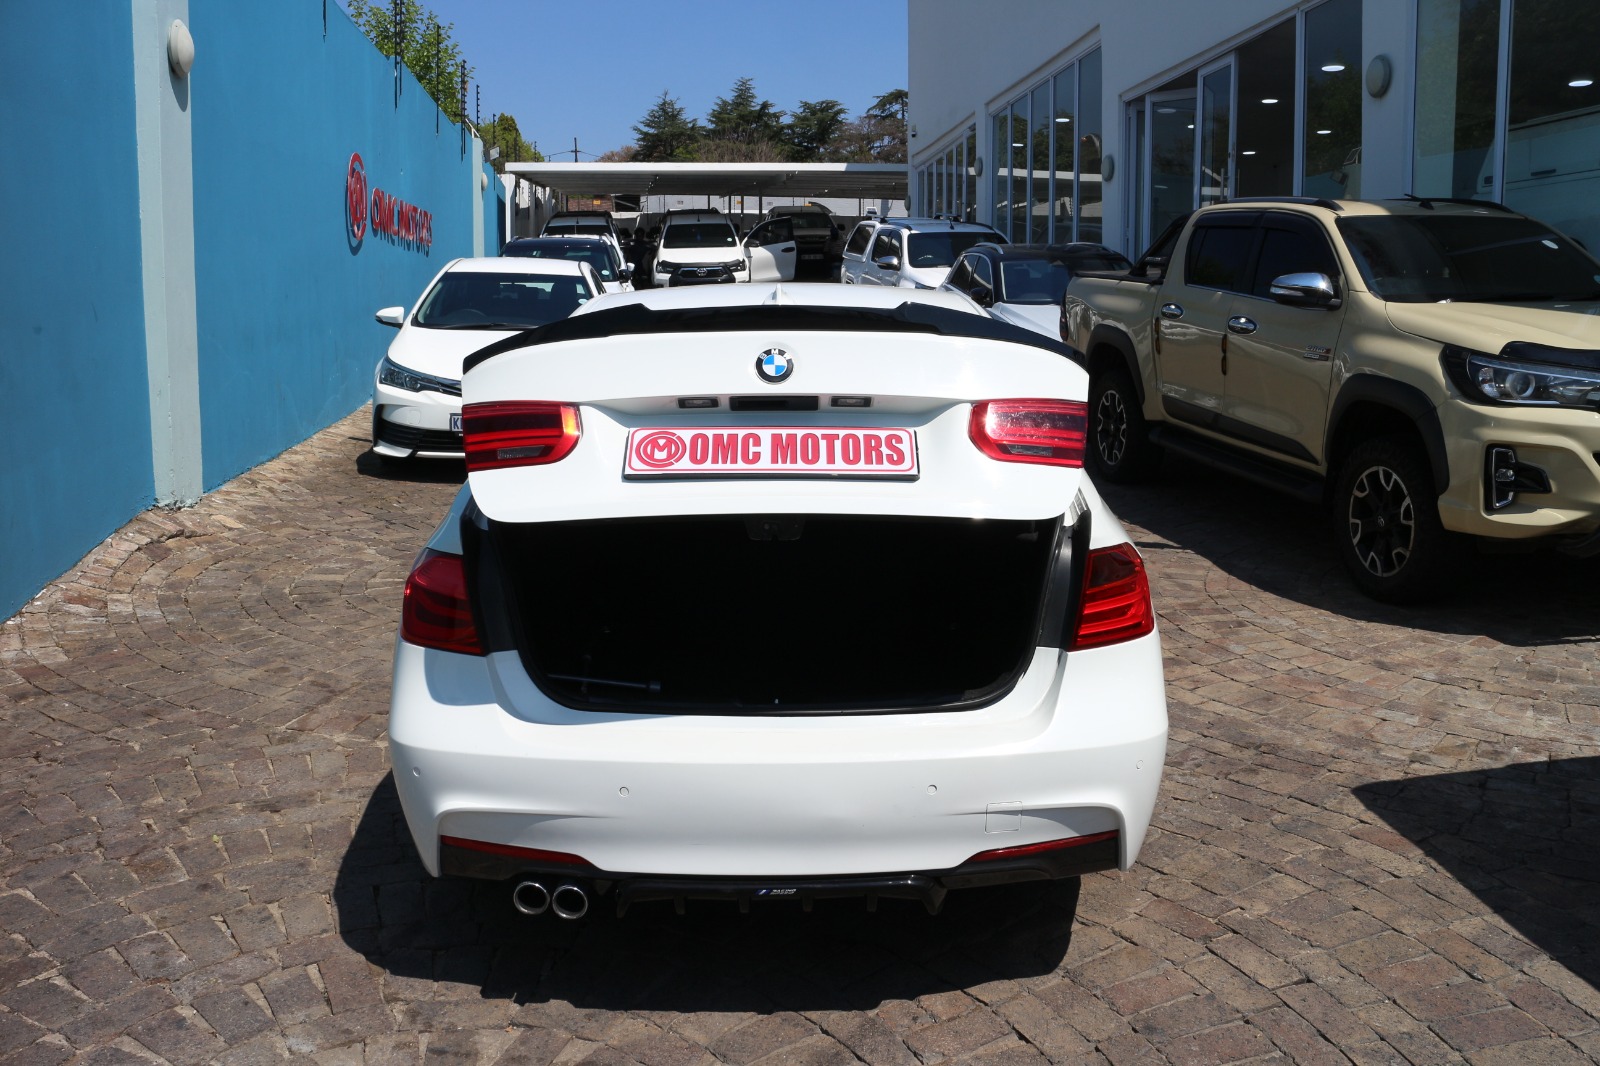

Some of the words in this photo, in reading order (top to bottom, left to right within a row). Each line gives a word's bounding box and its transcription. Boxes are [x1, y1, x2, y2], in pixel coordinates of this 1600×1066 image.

[371, 187, 398, 237] OMC
[399, 199, 433, 248] MOTORS
[689, 432, 762, 466] OMC
[770, 433, 906, 466] MOTORS
